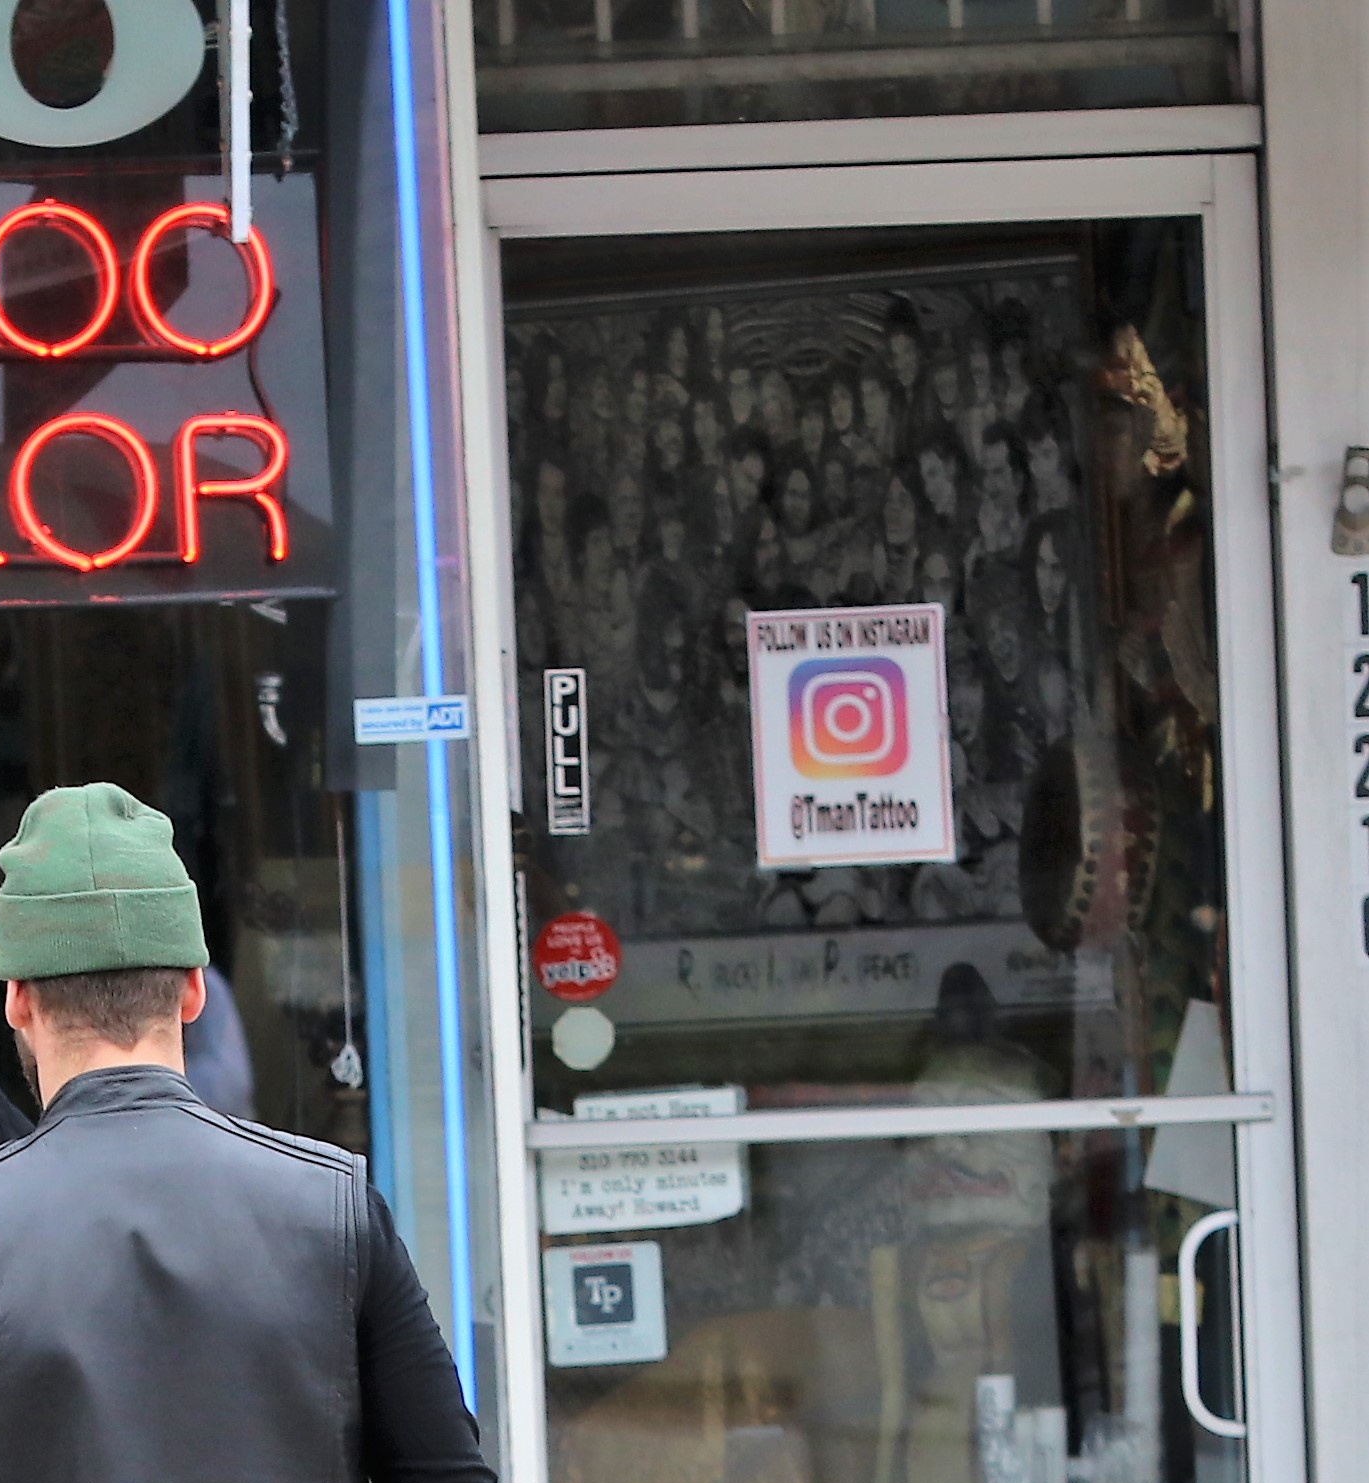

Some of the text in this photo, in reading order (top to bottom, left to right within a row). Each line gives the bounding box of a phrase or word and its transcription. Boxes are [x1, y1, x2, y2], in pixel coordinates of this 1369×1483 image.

[757, 615, 931, 651] FOLLOW US ON INSTAGRAM
[427, 704, 463, 730] ADT
[551, 676, 581, 796] PULL
[790, 792, 919, 840] @TmanTattoo
[600, 1174, 646, 1195] only
[655, 1171, 728, 1190] minutes
